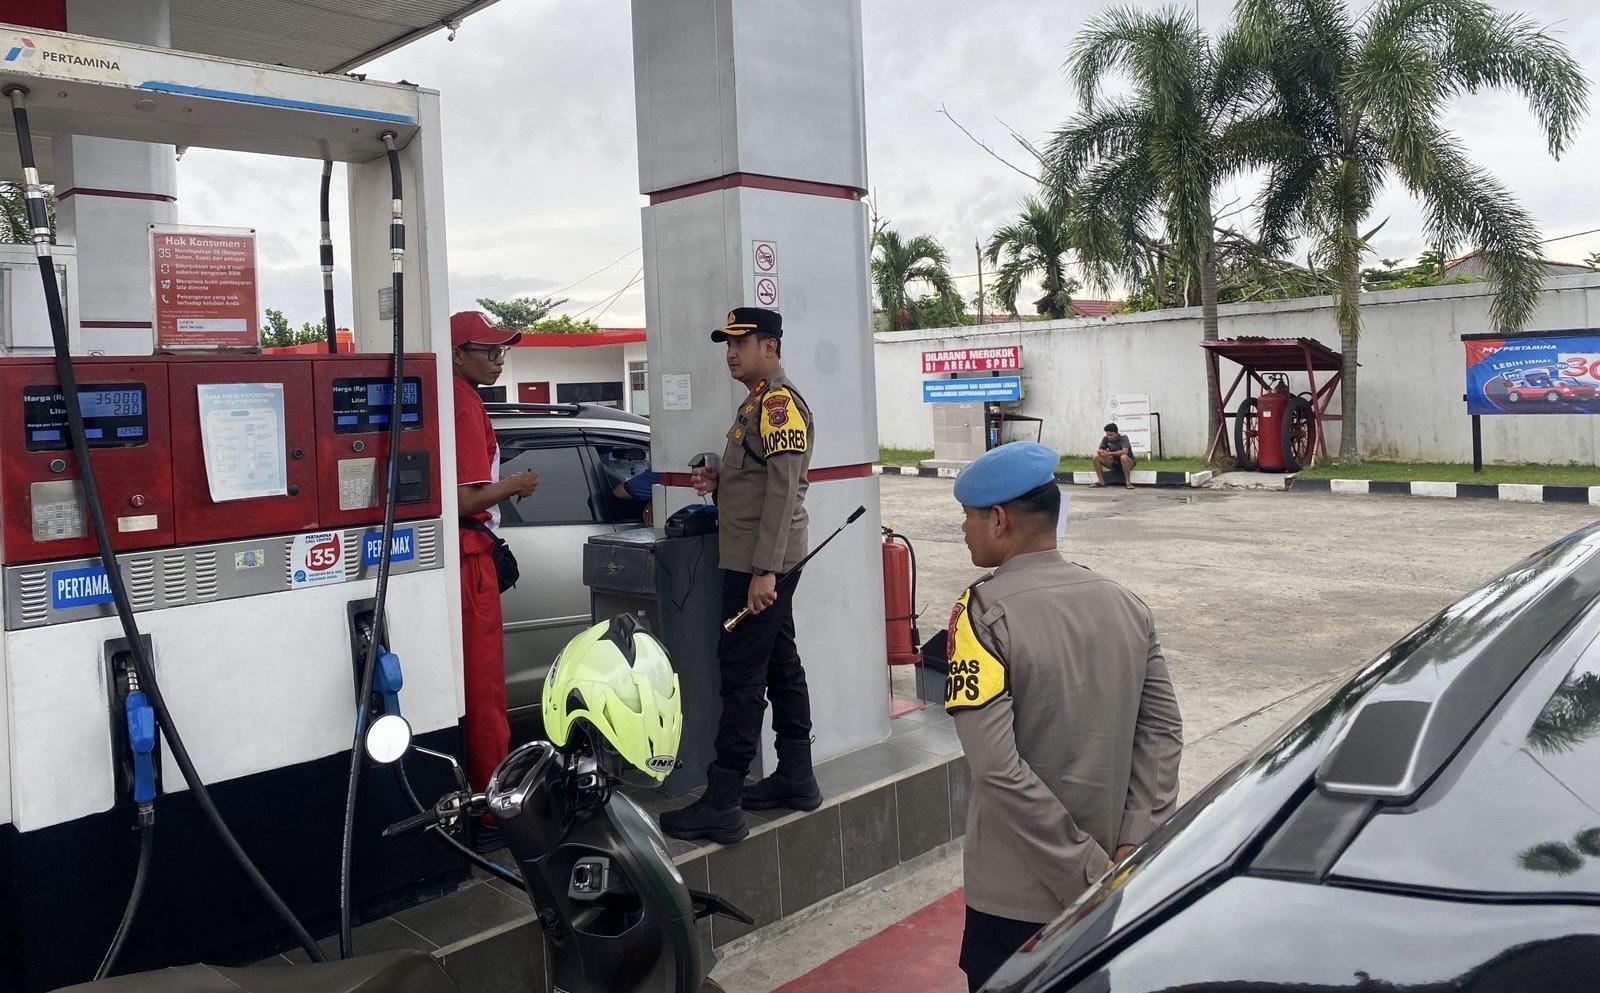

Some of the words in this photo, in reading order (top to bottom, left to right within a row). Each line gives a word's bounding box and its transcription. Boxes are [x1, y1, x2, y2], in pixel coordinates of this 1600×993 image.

[42, 51, 120, 70] PERTAMINA
[165, 237, 187, 246] Hak
[189, 238, 241, 248] Konsumen
[925, 352, 967, 361] DILARANG
[969, 348, 1014, 359] MEROKOK
[925, 362, 936, 372] DI
[944, 361, 977, 371] AREAL
[986, 358, 1015, 369] SPBU
[1493, 360, 1523, 370] LEBIH
[333, 385, 352, 393] Harga
[24, 395, 51, 403] Harga
[96, 392, 139, 404] 35000
[762, 429, 788, 456] AOPS
[788, 429, 806, 450] RES
[367, 535, 410, 559] PERMAX
[306, 547, 336, 567] 135
[57, 573, 112, 601] PERTAMA
[947, 659, 980, 676] GAS
[650, 759, 674, 768] INK
